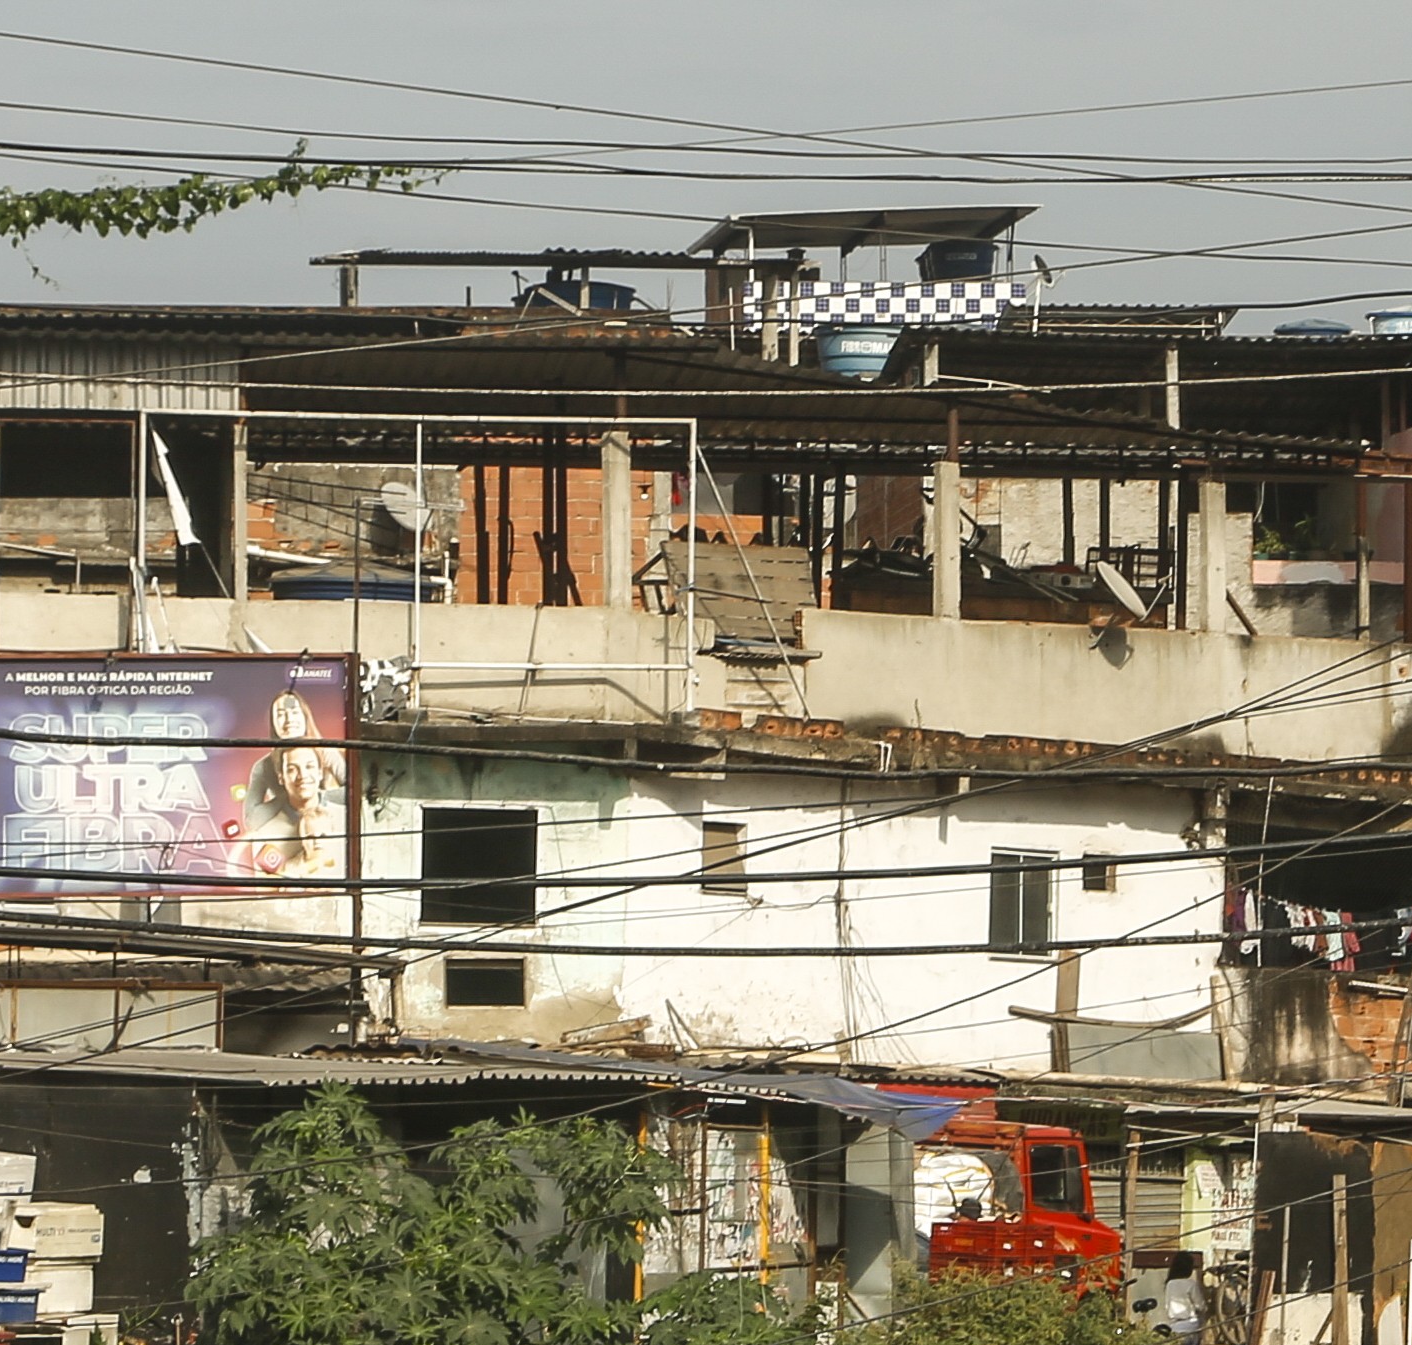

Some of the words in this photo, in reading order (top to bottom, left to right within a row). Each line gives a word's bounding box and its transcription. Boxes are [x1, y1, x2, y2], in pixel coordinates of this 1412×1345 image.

[4, 672, 13, 682] A
[15, 671, 65, 682] MELHOR
[67, 672, 76, 682] E
[77, 672, 108, 682] MAIS
[109, 669, 155, 682] RÁPIDA
[156, 671, 214, 682] INTERNET
[24, 686, 50, 695] POR
[51, 686, 85, 695] FIBRA
[86, 684, 128, 696] ÓPTICA
[130, 685, 146, 695] DA
[149, 684, 195, 696] REGIÃO.
[8, 712, 209, 764] SUPER
[14, 763, 211, 814] ULTRA
[2, 812, 231, 874] FIBRA
